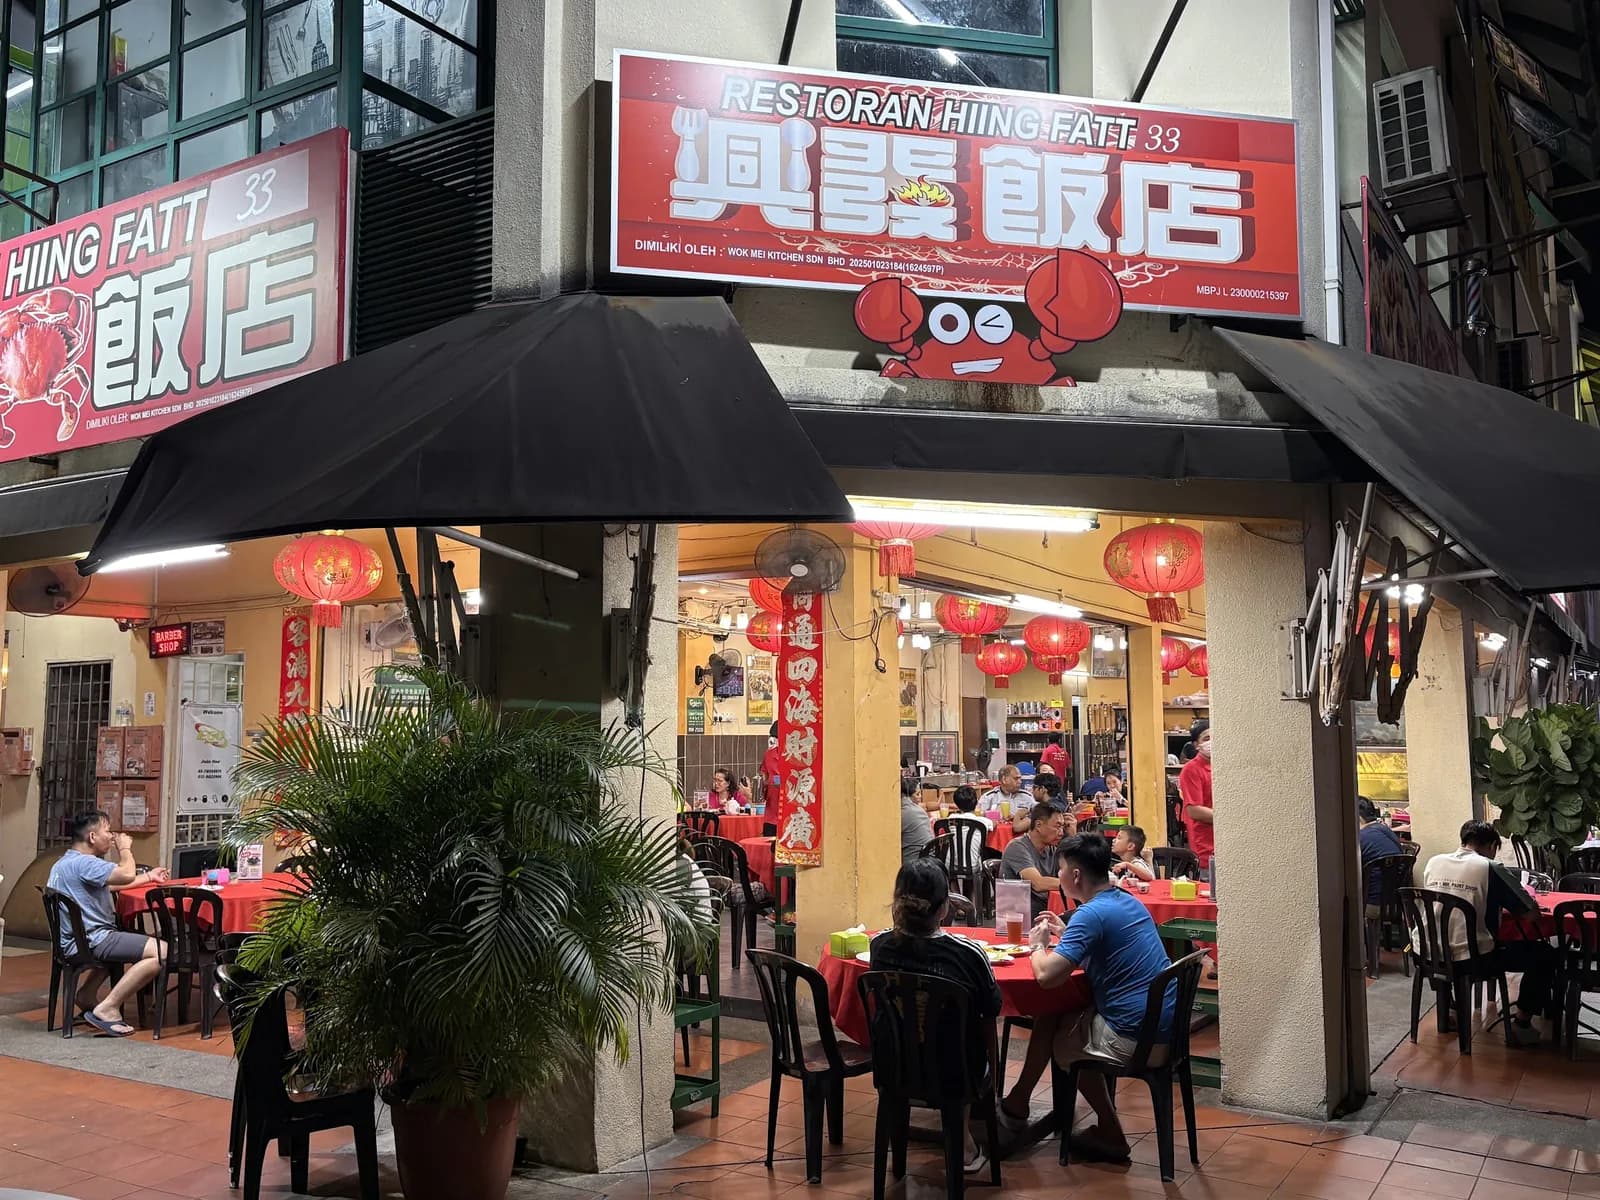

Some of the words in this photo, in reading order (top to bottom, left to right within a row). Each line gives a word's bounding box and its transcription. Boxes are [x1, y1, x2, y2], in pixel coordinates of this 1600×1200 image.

[721, 76, 932, 129] RESTORAN
[941, 98, 1041, 140] HIING
[1049, 111, 1138, 149] FATT
[1144, 124, 1181, 153] 33
[236, 167, 277, 221] 33
[4, 224, 101, 298] HIING
[109, 188, 208, 266] FATT
[635, 239, 681, 254] DIMILIKI
[684, 243, 717, 256] OLEH
[728, 247, 750, 258] WOK
[750, 249, 766, 259] MEI
[768, 251, 804, 262] KITCHEN
[805, 255, 824, 264] SDN
[827, 257, 846, 266] BHD
[850, 258, 945, 275] 202501023184(1624597P)
[1196, 284, 1221, 296] MBPJ
[1222, 287, 1229, 297] L
[95, 223, 315, 404] 飯店
[86, 416, 110, 430] DIMILIKI
[150, 406, 170, 418] KITCHEN
[183, 402, 194, 411] BHD
[155, 629, 182, 643] BARBER
[158, 641, 180, 653] SHOP
